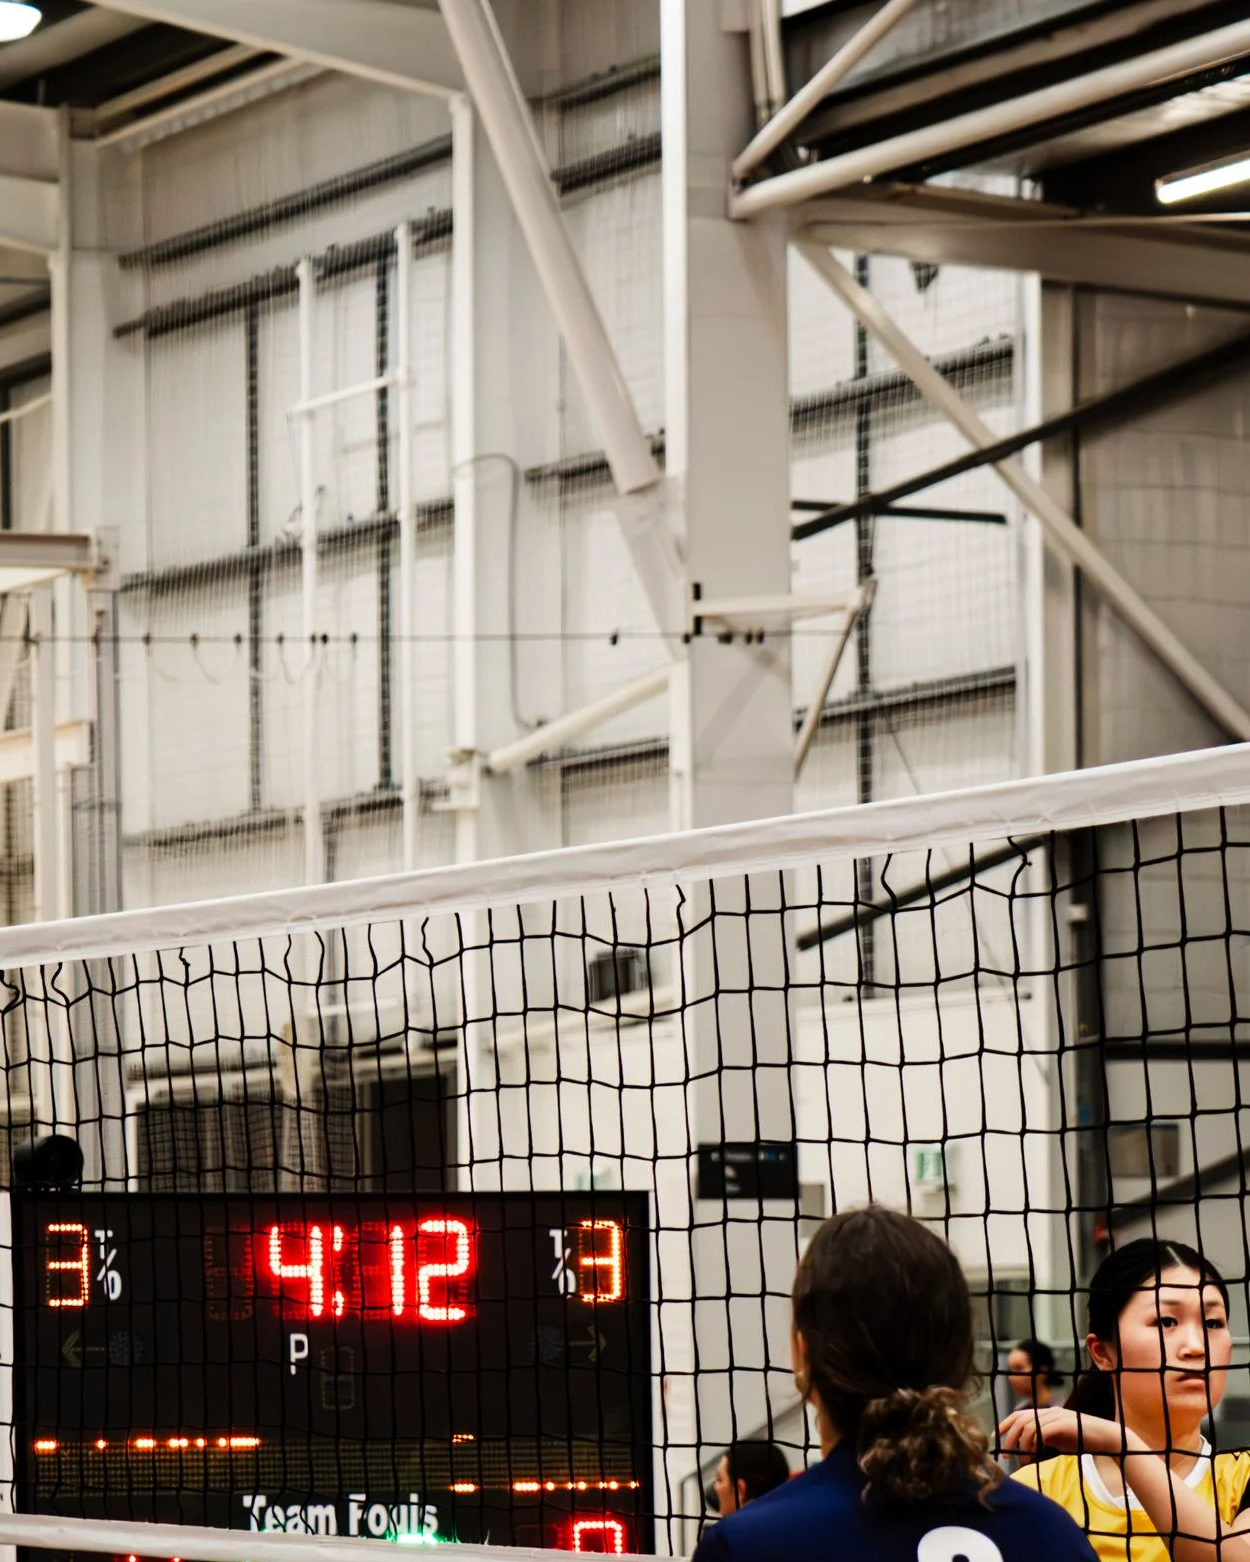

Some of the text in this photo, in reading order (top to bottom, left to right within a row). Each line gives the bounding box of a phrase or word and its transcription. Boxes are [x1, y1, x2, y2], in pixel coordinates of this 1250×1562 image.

[48, 1222, 89, 1307] 3
[580, 1219, 623, 1303] 3
[289, 1333, 309, 1376] P
[242, 1494, 338, 1537] Team
